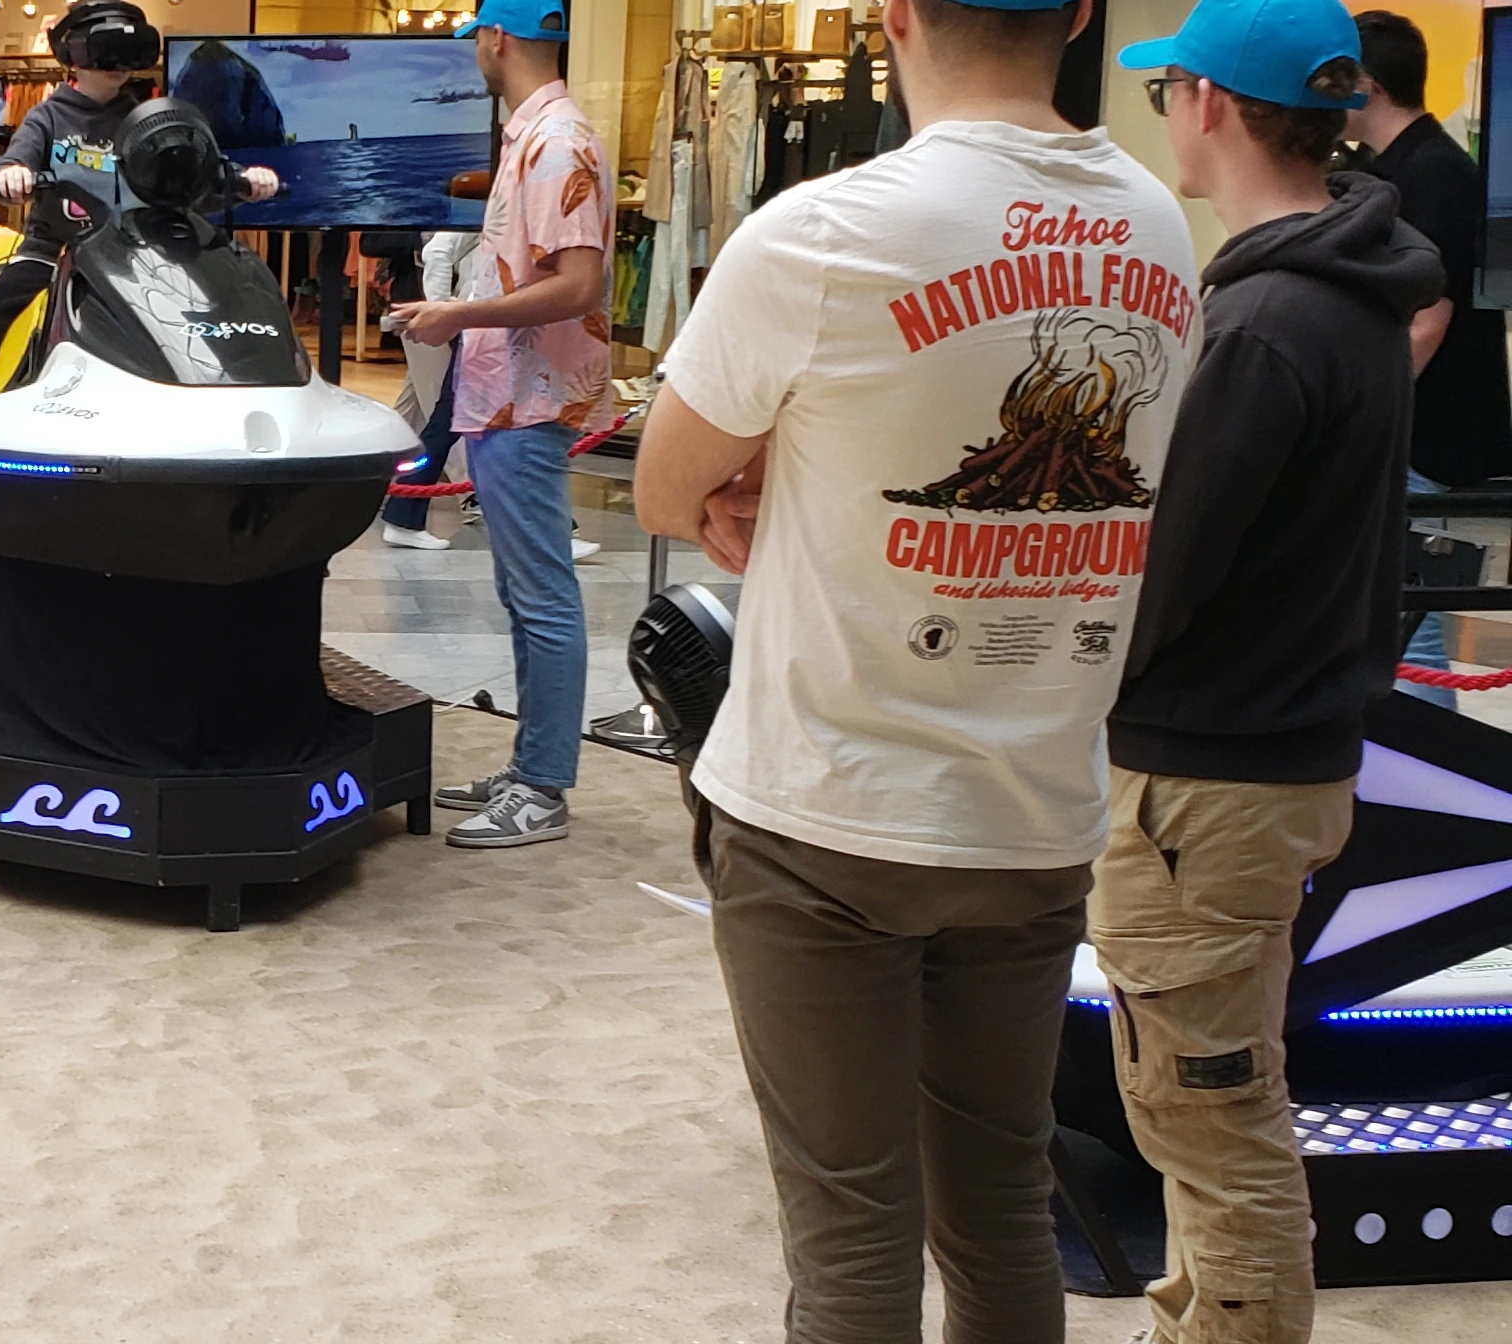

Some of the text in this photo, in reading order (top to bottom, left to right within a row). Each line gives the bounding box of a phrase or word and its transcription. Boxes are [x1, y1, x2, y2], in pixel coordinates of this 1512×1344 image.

[1002, 201, 1132, 252] Tahoe
[888, 252, 1194, 354] NATIONAL FOREST
[934, 582, 980, 600] and
